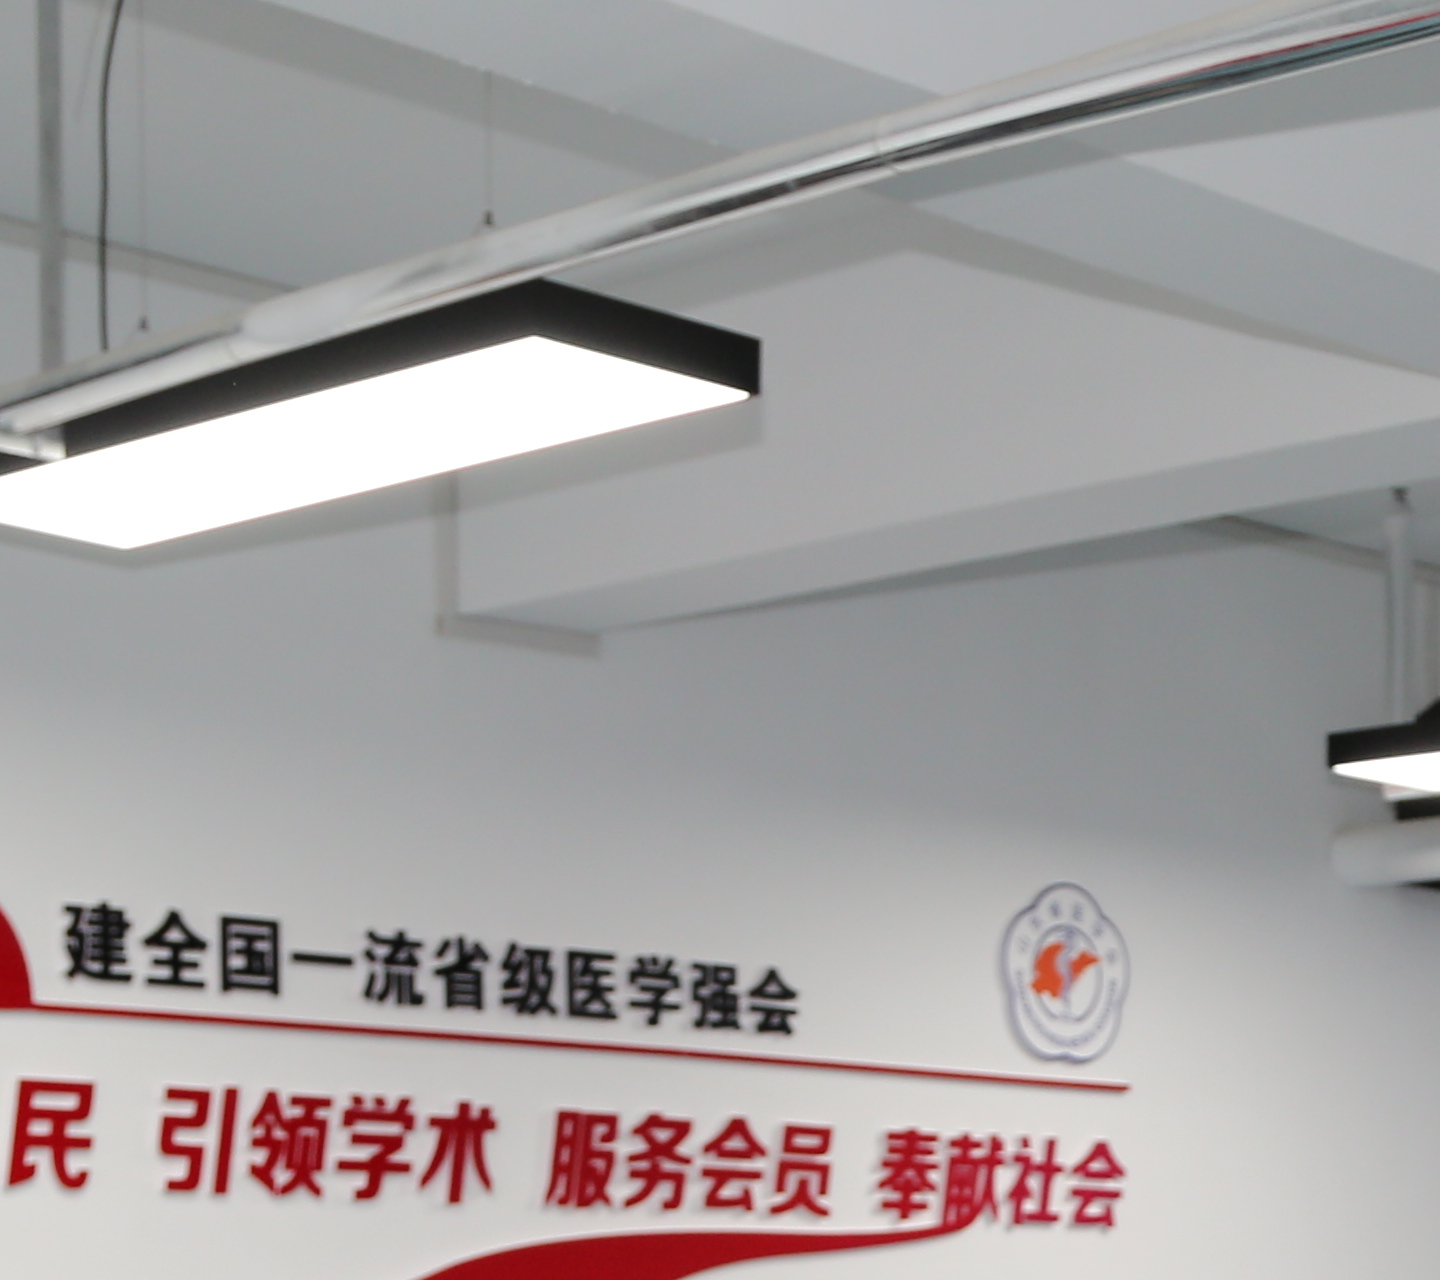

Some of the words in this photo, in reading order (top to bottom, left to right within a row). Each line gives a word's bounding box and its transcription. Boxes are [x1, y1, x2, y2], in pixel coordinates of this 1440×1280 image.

[62, 900, 803, 1036] 建全国一流省级医学强会
[157, 1084, 498, 1206] 引领学术
[542, 1108, 834, 1220] 服务会员
[874, 1128, 1132, 1230] 奉献社会
